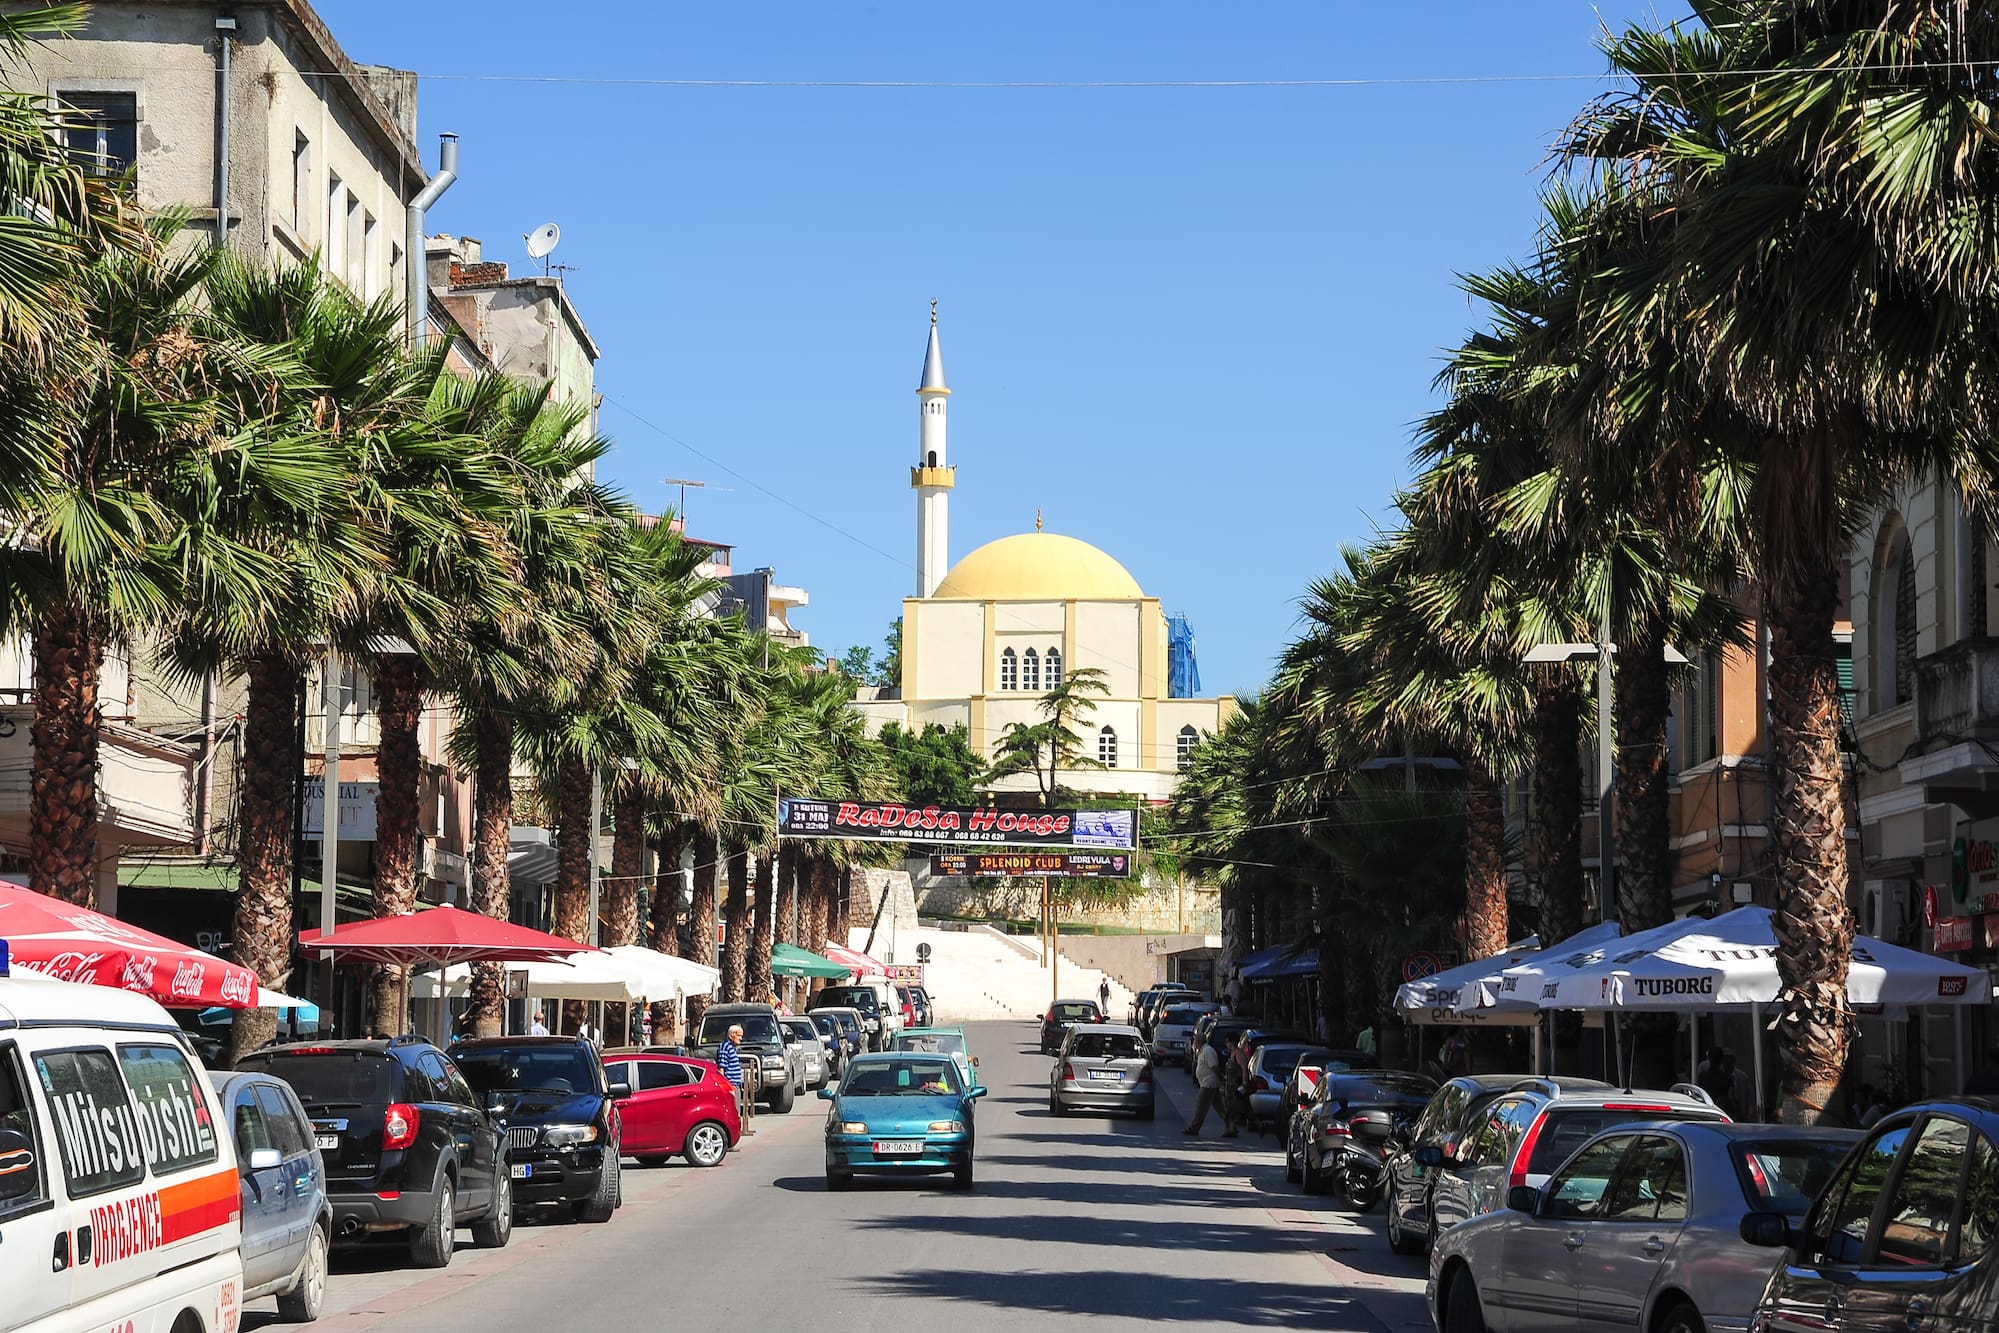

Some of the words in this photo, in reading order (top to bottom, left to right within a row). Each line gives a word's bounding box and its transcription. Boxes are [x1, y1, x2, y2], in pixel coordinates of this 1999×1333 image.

[794, 812, 806, 821] 31
[809, 812, 829, 822] MAJ
[836, 801, 960, 830] RaDeSa
[969, 807, 1070, 836] House
[805, 822, 829, 830] 22:00
[980, 857, 1031, 868] SPLENDID
[1035, 857, 1061, 868] CLUB
[1069, 856, 1091, 864] LEDRI
[1091, 856, 1111, 864] VULA
[8, 951, 105, 985] oca-Cola
[1635, 976, 1712, 996] TUBORG
[1942, 980, 1963, 988] 100%
[1425, 988, 1461, 1005] Spr
[328, 1136, 335, 1147] P
[881, 1143, 891, 1152] DR
[893, 1143, 912, 1152] 0626
[513, 1166, 525, 1177] HG
[90, 1192, 161, 1268] URRGJENCE
